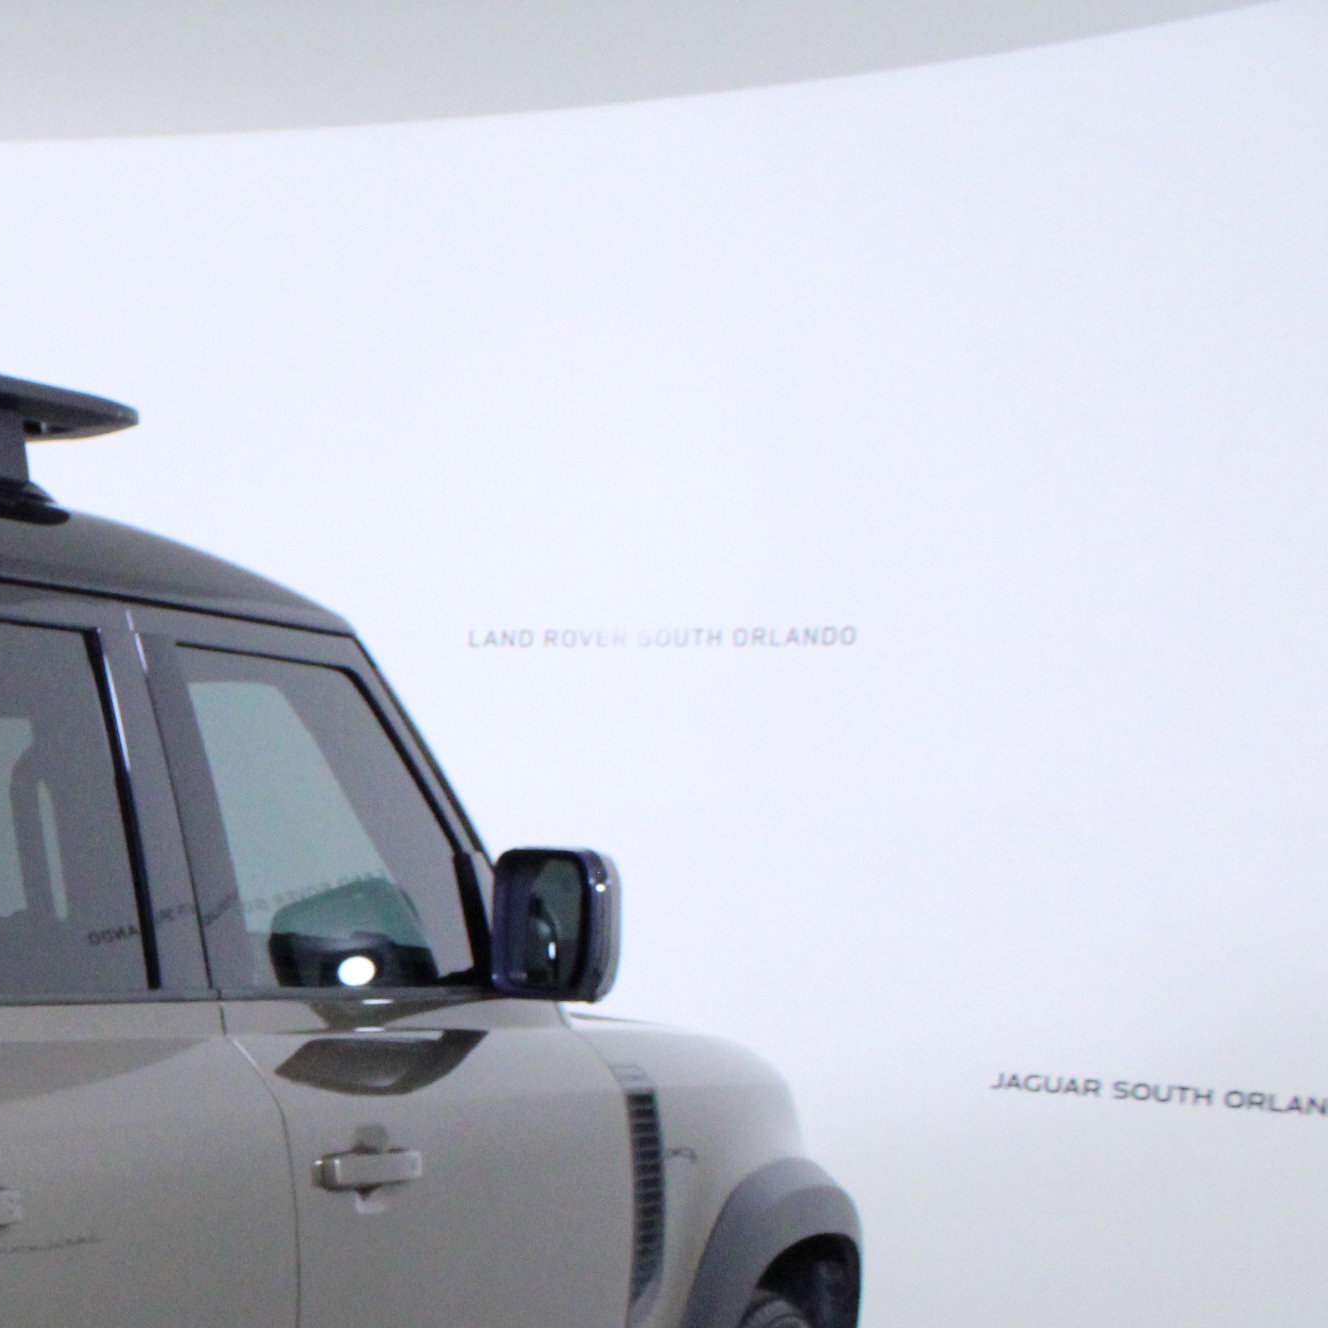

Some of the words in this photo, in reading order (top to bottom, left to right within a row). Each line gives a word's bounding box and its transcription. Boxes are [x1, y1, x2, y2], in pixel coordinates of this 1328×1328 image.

[467, 629, 535, 649] LAND
[543, 628, 627, 649] ROVER
[637, 626, 724, 648] SOUTH
[731, 625, 858, 648] ORLANDO
[990, 1072, 1103, 1097] JAGUAR
[1112, 1080, 1215, 1106] SOUTH
